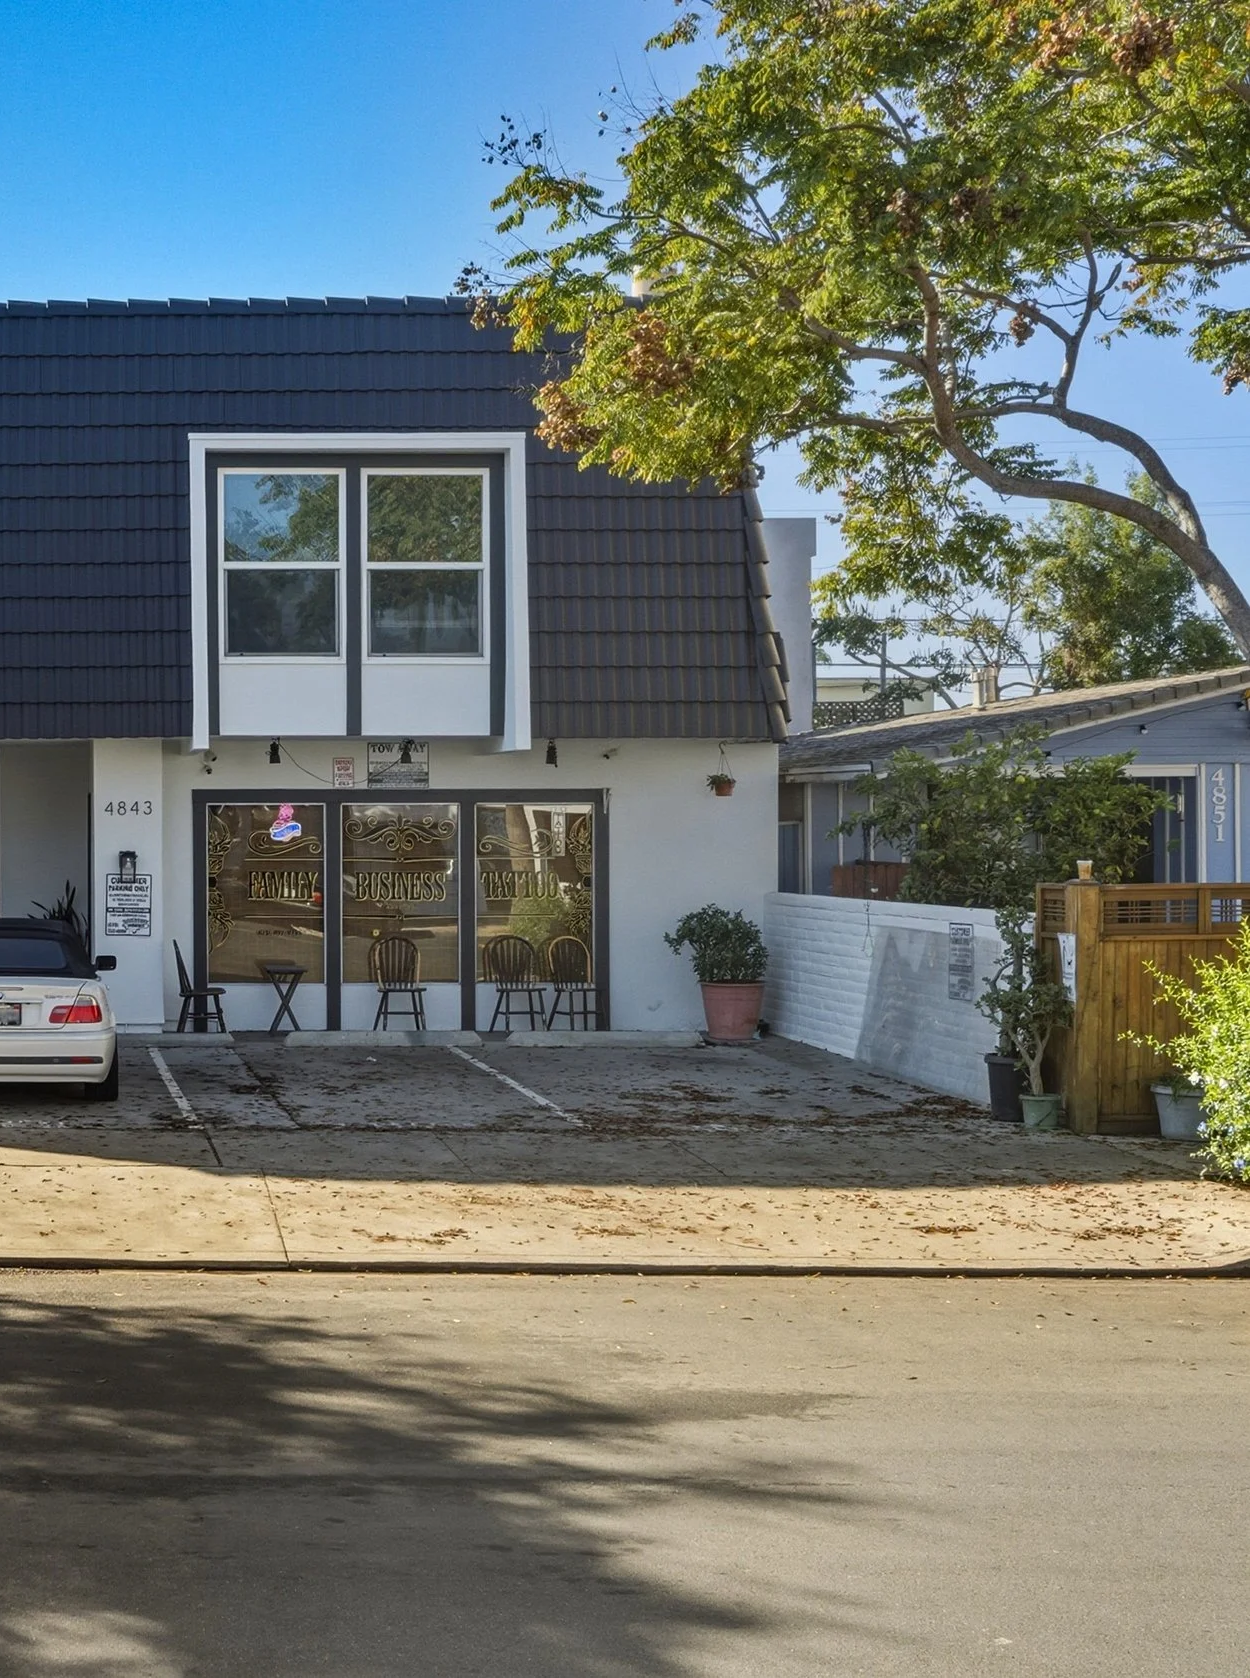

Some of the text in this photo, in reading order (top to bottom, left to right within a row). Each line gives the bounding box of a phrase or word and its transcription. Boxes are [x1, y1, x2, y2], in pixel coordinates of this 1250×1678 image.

[370, 744, 394, 753] TOW
[104, 800, 153, 816] 4843
[1211, 768, 1227, 842] 4851
[249, 871, 560, 902] FAMILY BUSINESS TATTOO
